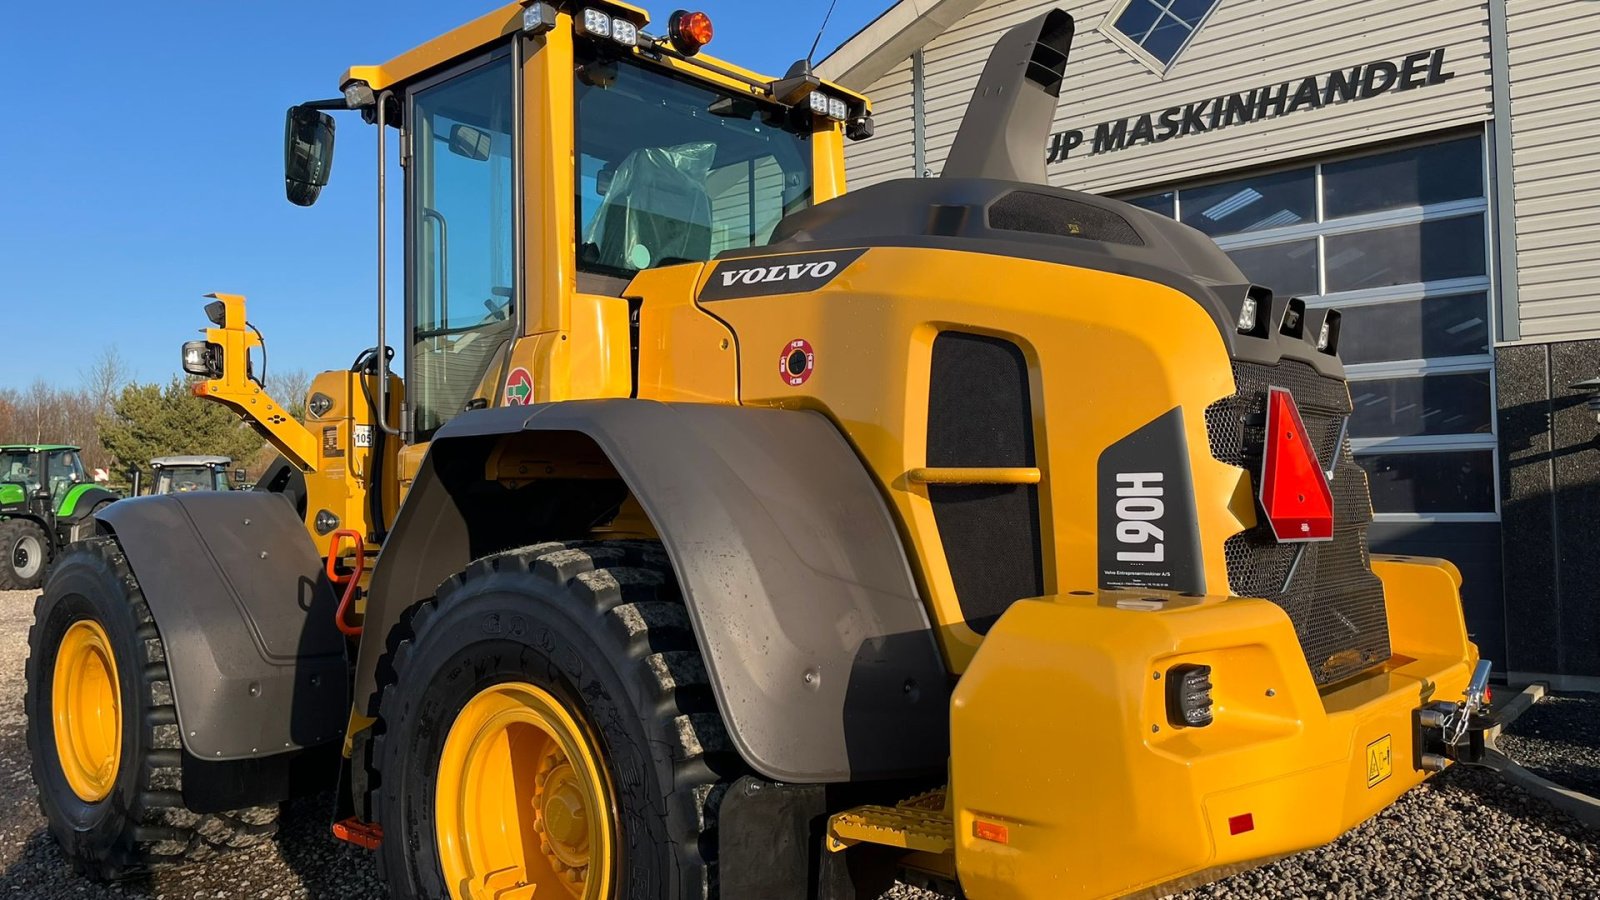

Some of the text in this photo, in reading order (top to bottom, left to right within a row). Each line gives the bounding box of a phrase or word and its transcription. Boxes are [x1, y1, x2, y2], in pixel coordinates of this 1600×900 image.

[1093, 48, 1455, 153] MASKINHANDEL
[720, 261, 837, 286] VOLVO
[356, 433, 372, 444] 105
[1116, 472, 1164, 562] L90H
